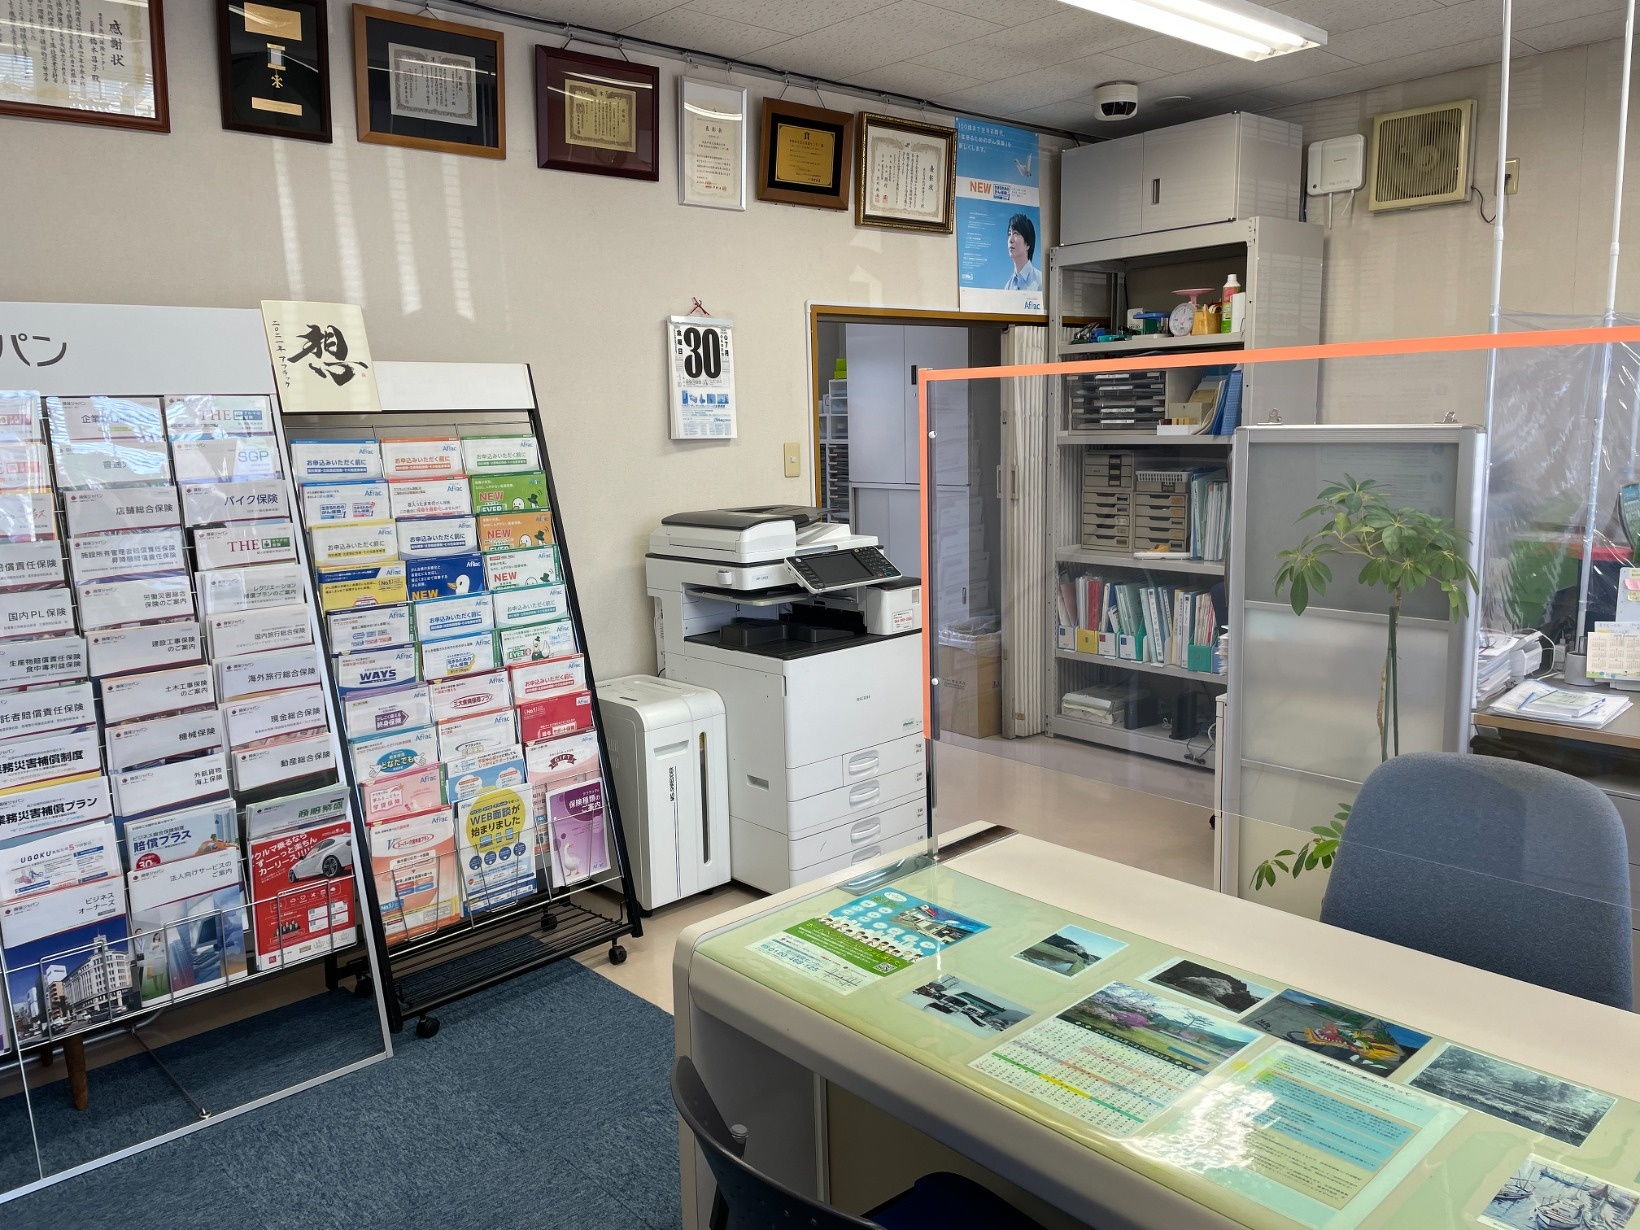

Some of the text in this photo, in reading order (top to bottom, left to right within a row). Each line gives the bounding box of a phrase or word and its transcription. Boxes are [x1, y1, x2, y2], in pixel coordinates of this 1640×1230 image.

[109, 19, 125, 67] 感謝状
[970, 181, 992, 195] NEW
[1024, 301, 1041, 310] Aflac
[287, 324, 368, 386] 想
[683, 327, 722, 378] 30
[198, 410, 231, 421] THE
[238, 450, 269, 464] SGP
[395, 456, 450, 464] お申込みいただく前に
[476, 452, 526, 460] お申込みいただく前に
[307, 459, 367, 467] お申込みいただく前に
[364, 490, 382, 498] Aflac
[447, 485, 463, 493] Aflac
[225, 494, 279, 506] バイク保険
[479, 491, 504, 502] NEW
[115, 503, 173, 516] 店舗総合保険
[410, 533, 465, 543] お申込みいただく前に
[487, 529, 511, 540] NEW
[228, 541, 260, 553] THE
[328, 541, 385, 551] お申込みいただく前に
[494, 572, 517, 583] NEW
[253, 583, 296, 592] レクリエーション
[144, 591, 186, 601] 労働災害総合
[243, 588, 296, 600] 補償プランのご案内
[412, 588, 438, 600] NEW
[145, 598, 187, 608] 保険のご案内
[507, 600, 556, 612] お申込みいただく前に
[388, 612, 406, 621] Aflac
[429, 611, 481, 623] お申込みいただく前に
[255, 628, 306, 640] 国内旅行総合保険
[152, 636, 195, 648] 建設工事保険
[168, 643, 195, 653] のご案内
[10, 653, 81, 667] 生産物賠償責任保険
[395, 652, 413, 661] Aflac
[508, 650, 524, 659] EVER
[26, 660, 81, 673] 食中毒利益保険
[248, 668, 316, 682] 海外旅行総合保険
[359, 668, 397, 682] WAYS
[525, 674, 573, 687] お申込みいただく前に
[165, 680, 207, 692] 土木工事保険
[181, 687, 208, 697] のご案内
[271, 707, 320, 723] 現金総合保険
[179, 727, 215, 741] 機械保険
[415, 734, 432, 742] Aflac
[280, 751, 331, 768] 動産総合保険
[555, 754, 571, 762] GIFT
[195, 775, 223, 786] 海上保険
[420, 776, 437, 784] Aflac
[431, 816, 448, 824] Aflac
[471, 806, 525, 829] WEB面談が
[472, 819, 526, 842] 始まりました
[133, 830, 192, 852] 賠償プラス
[170, 861, 232, 882] 法人向けサービスの
[212, 869, 233, 879] ご案内
[86, 892, 115, 905] ビジネス
[78, 899, 116, 915] オーナーズ
